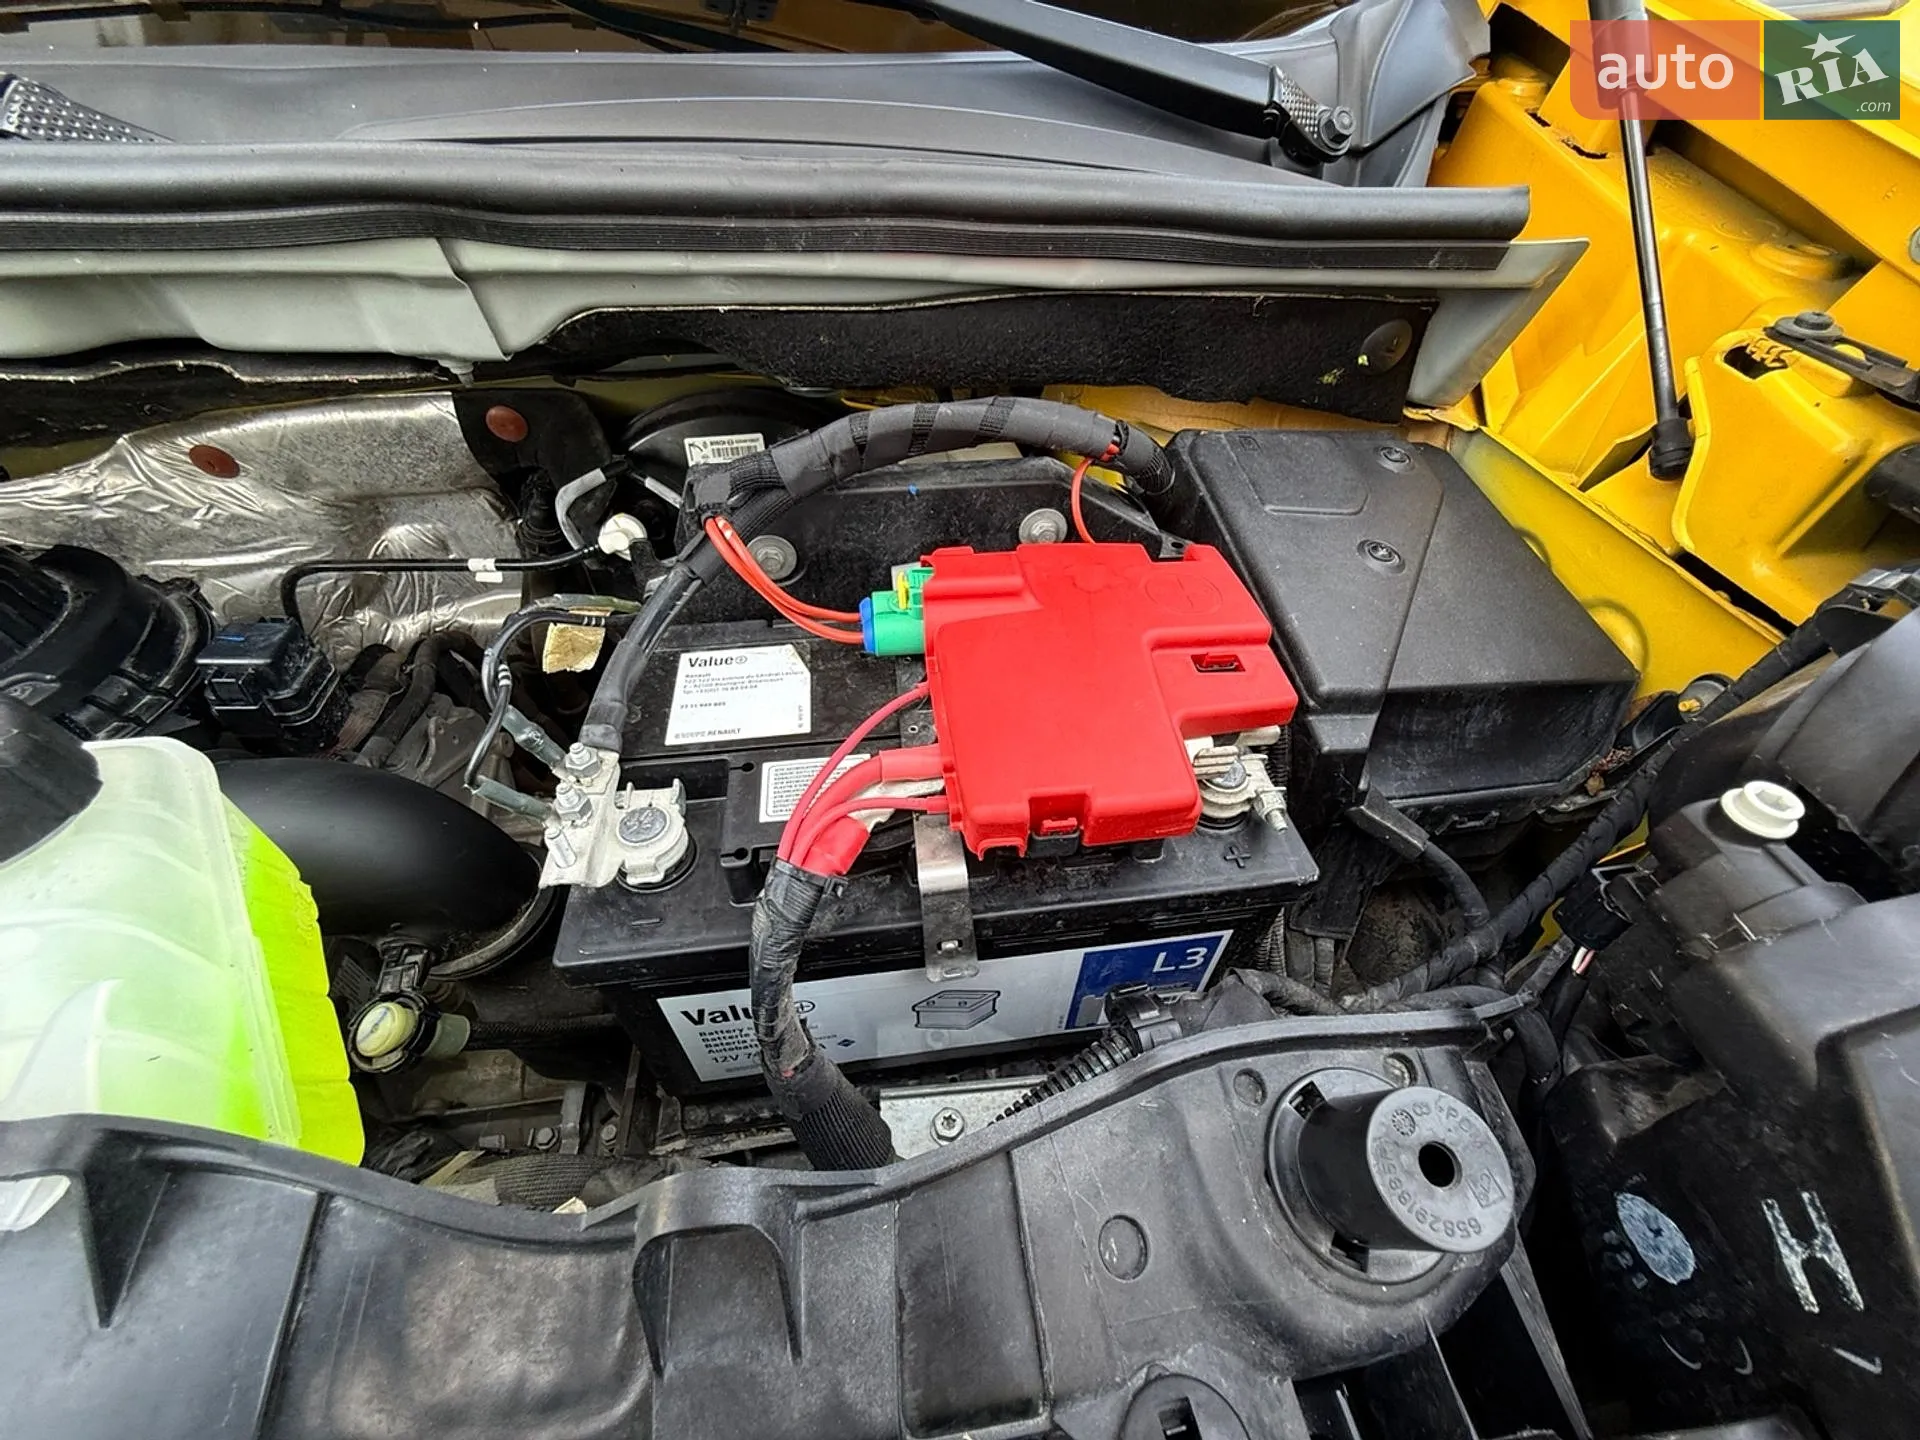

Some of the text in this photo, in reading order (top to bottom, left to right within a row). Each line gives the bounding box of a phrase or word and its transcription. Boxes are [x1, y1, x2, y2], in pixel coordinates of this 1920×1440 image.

[688, 655, 734, 668] Value
[1152, 947, 1208, 973] L3
[680, 1003, 752, 1027] Valu
[699, 1027, 744, 1037] Battery
[711, 1054, 739, 1063] 12V
